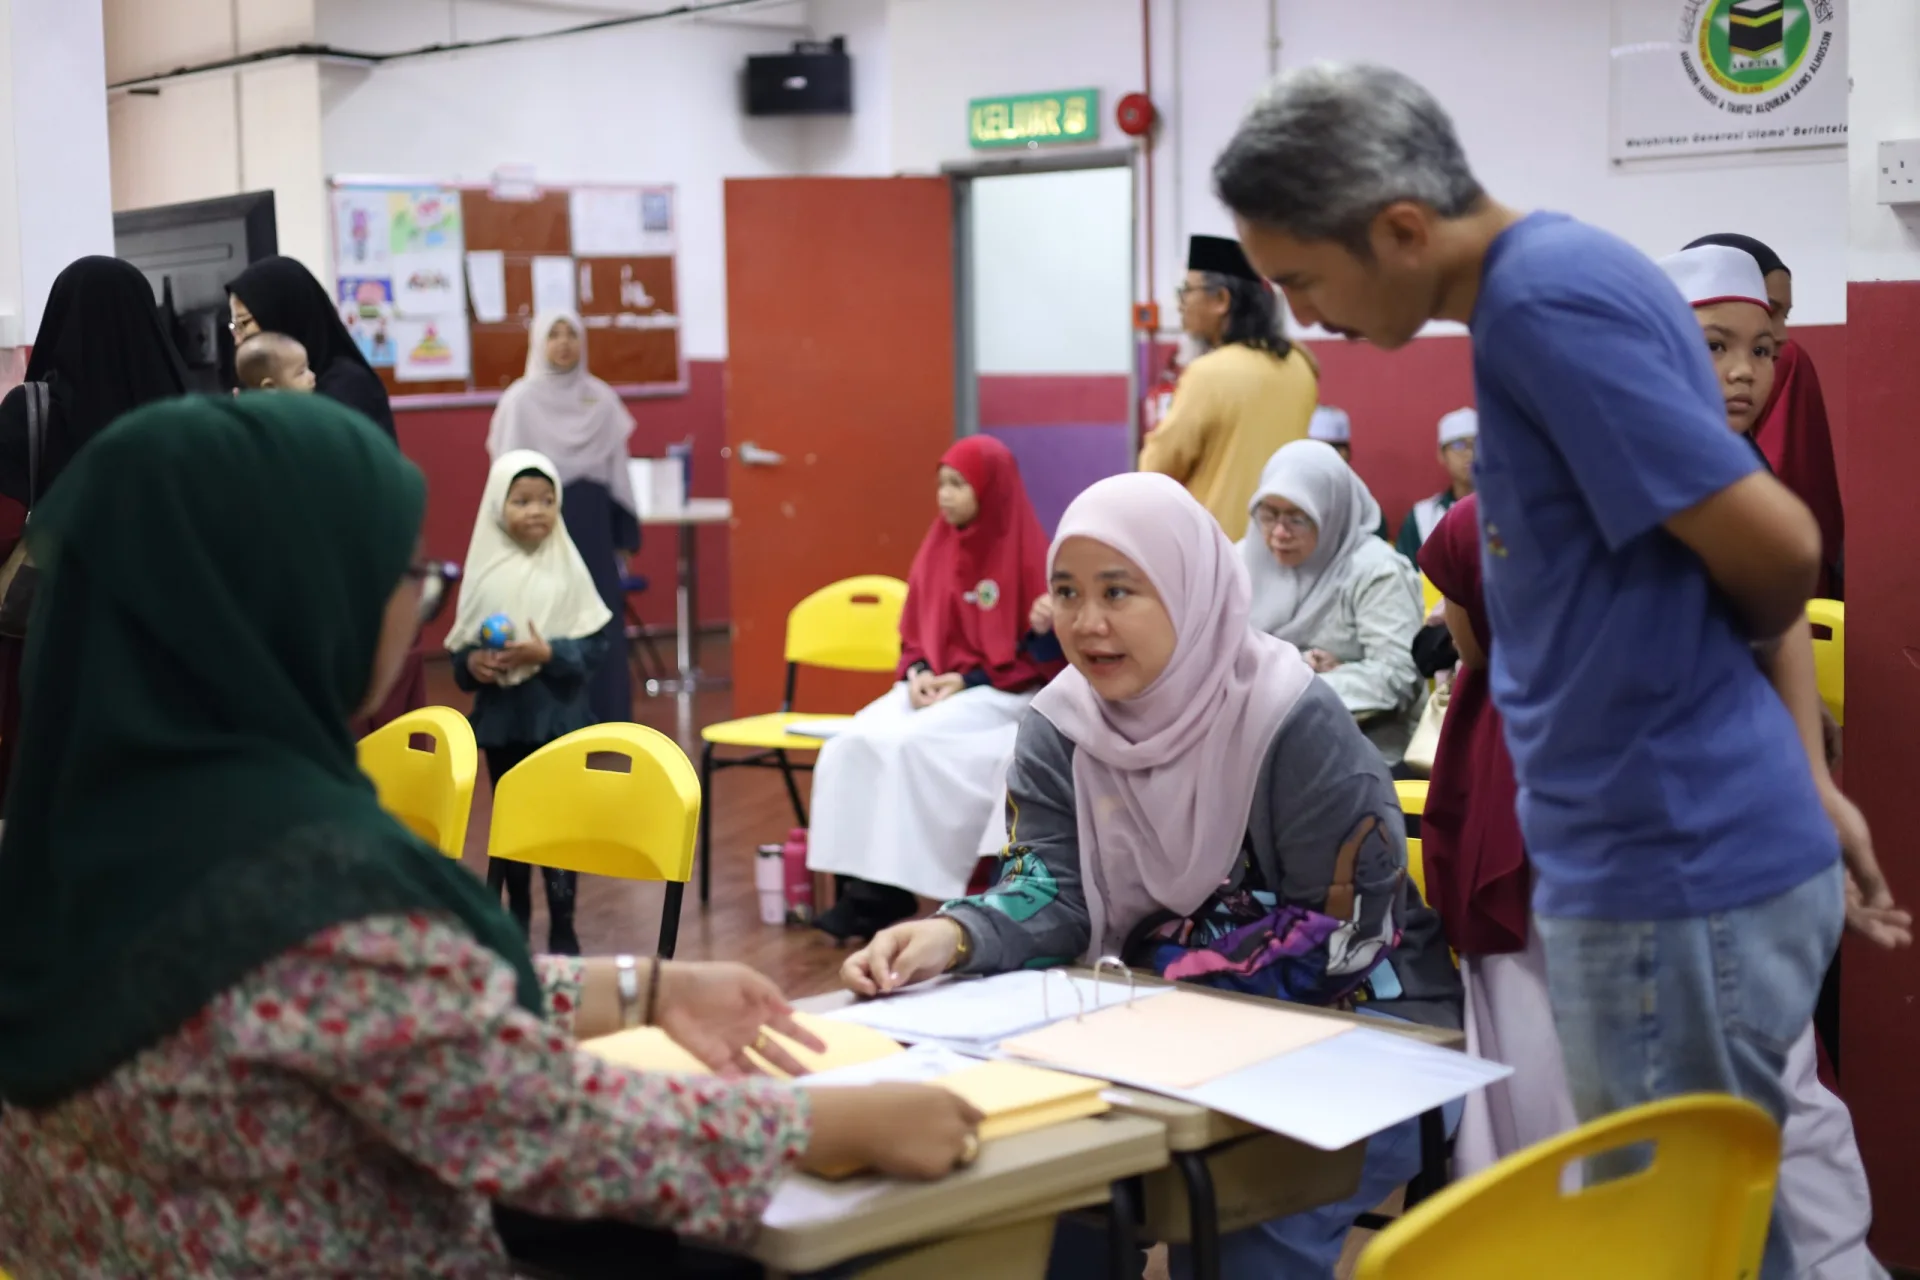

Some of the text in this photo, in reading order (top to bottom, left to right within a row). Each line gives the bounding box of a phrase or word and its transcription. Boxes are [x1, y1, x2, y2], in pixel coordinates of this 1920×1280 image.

[1756, 92, 1791, 113] ALQURAN
[1791, 74, 1812, 96] SAINS
[1809, 31, 1832, 74] ALHUSSIN
